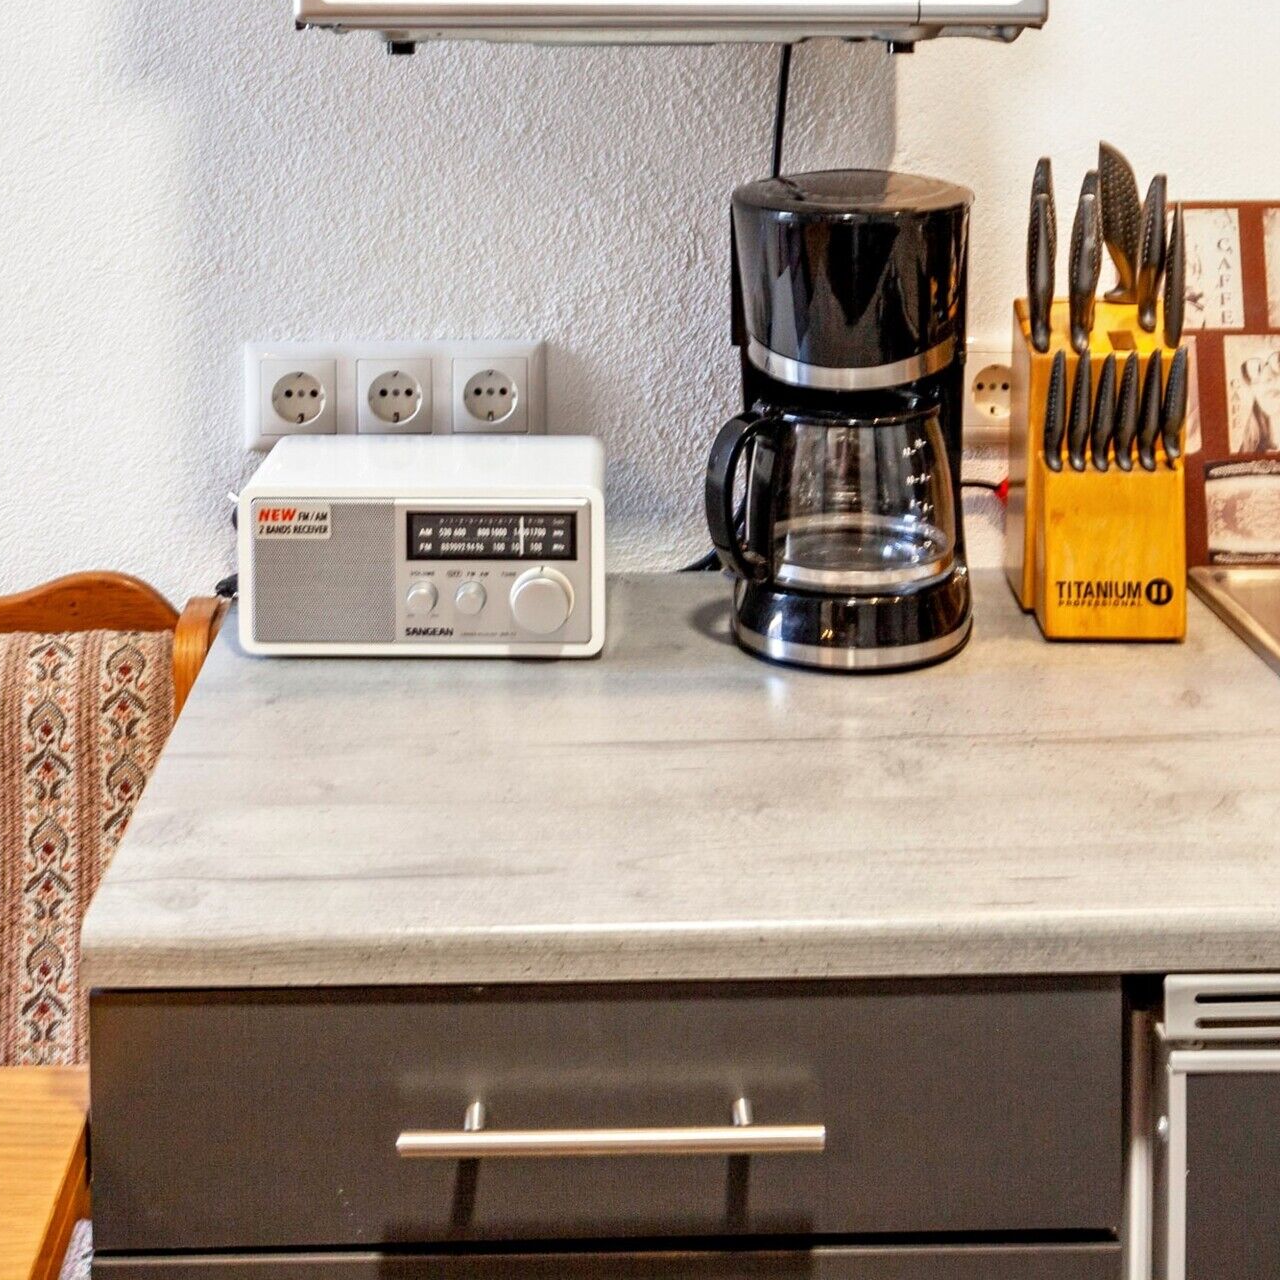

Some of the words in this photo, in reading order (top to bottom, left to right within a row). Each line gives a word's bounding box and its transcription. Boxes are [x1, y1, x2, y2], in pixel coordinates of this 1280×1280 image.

[259, 508, 297, 522] NEW
[266, 525, 292, 535] BANDS
[419, 527, 433, 537] AM
[419, 542, 433, 552] FM
[1055, 580, 1142, 599] TITANIUM
[405, 626, 454, 637] SANGEAN
